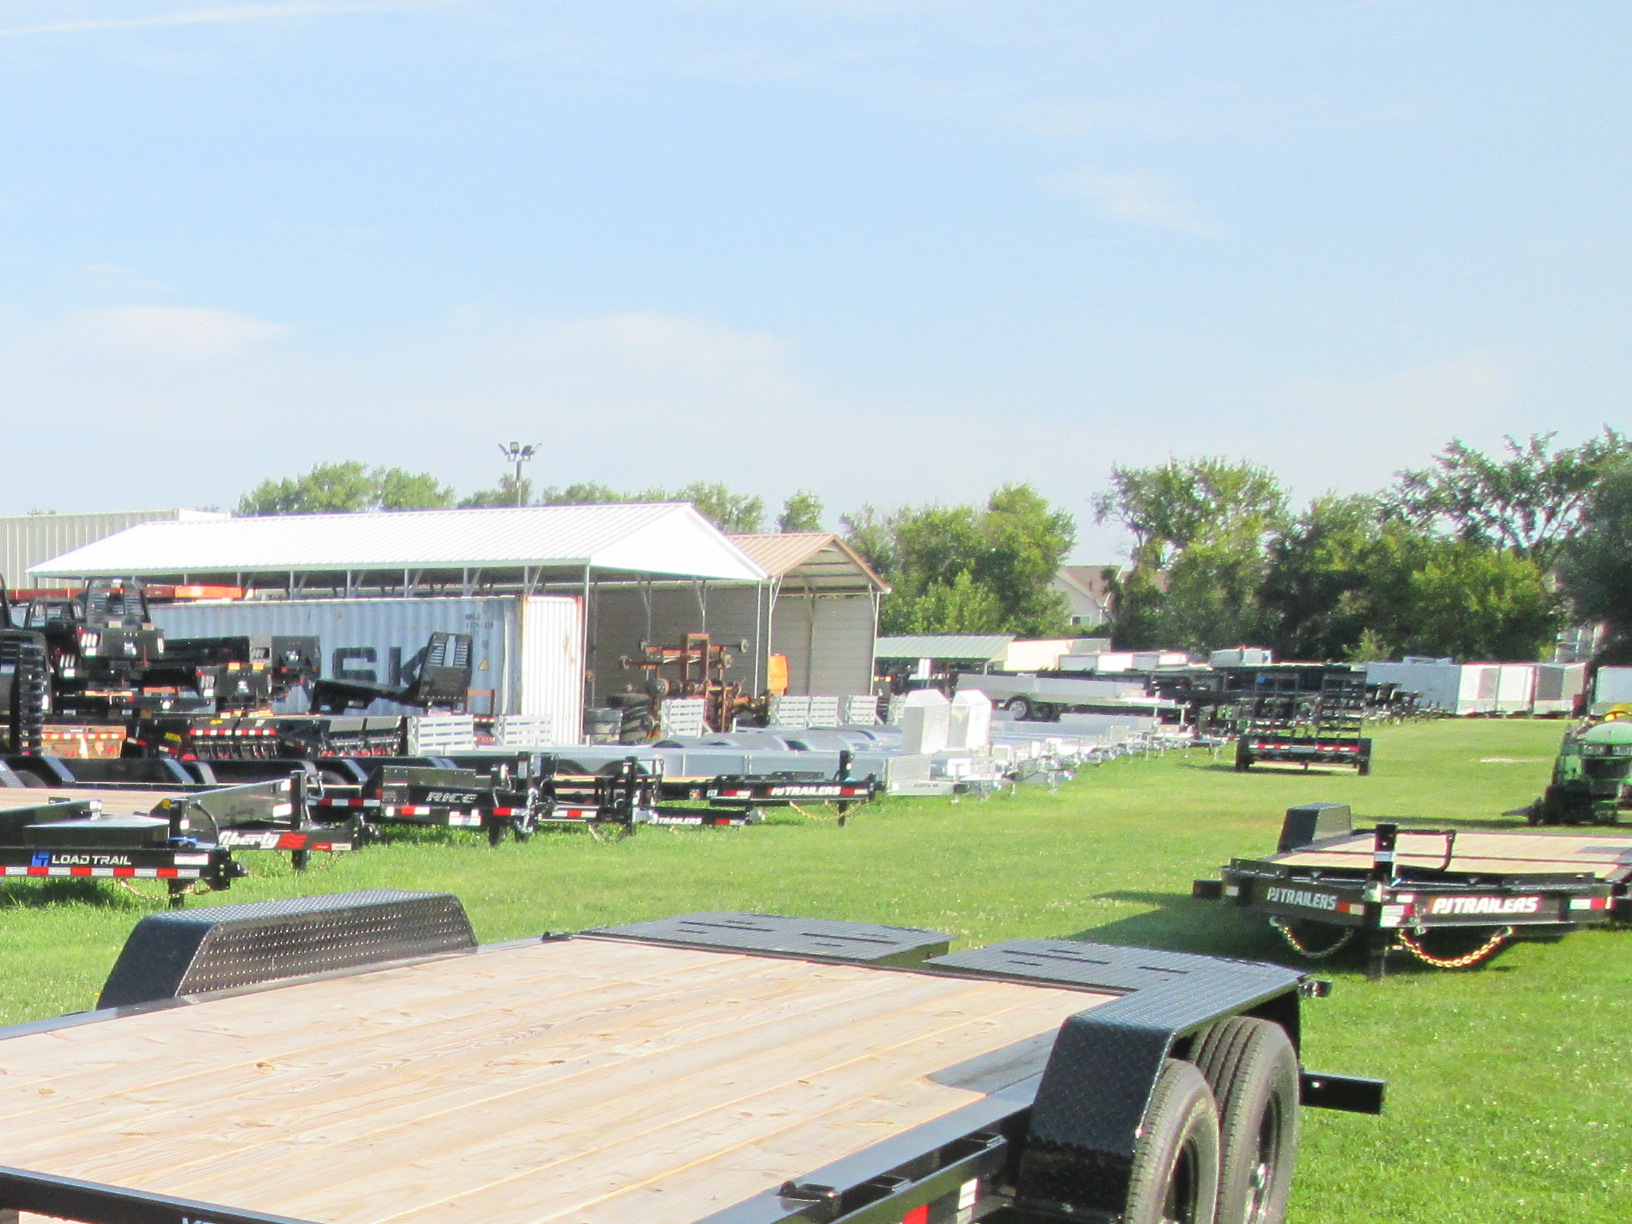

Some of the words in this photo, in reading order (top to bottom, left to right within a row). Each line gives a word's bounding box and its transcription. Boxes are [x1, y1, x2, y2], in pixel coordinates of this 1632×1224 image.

[425, 791, 478, 803] RICE
[51, 855, 90, 865] LOAD
[92, 856, 132, 866] TRAIL
